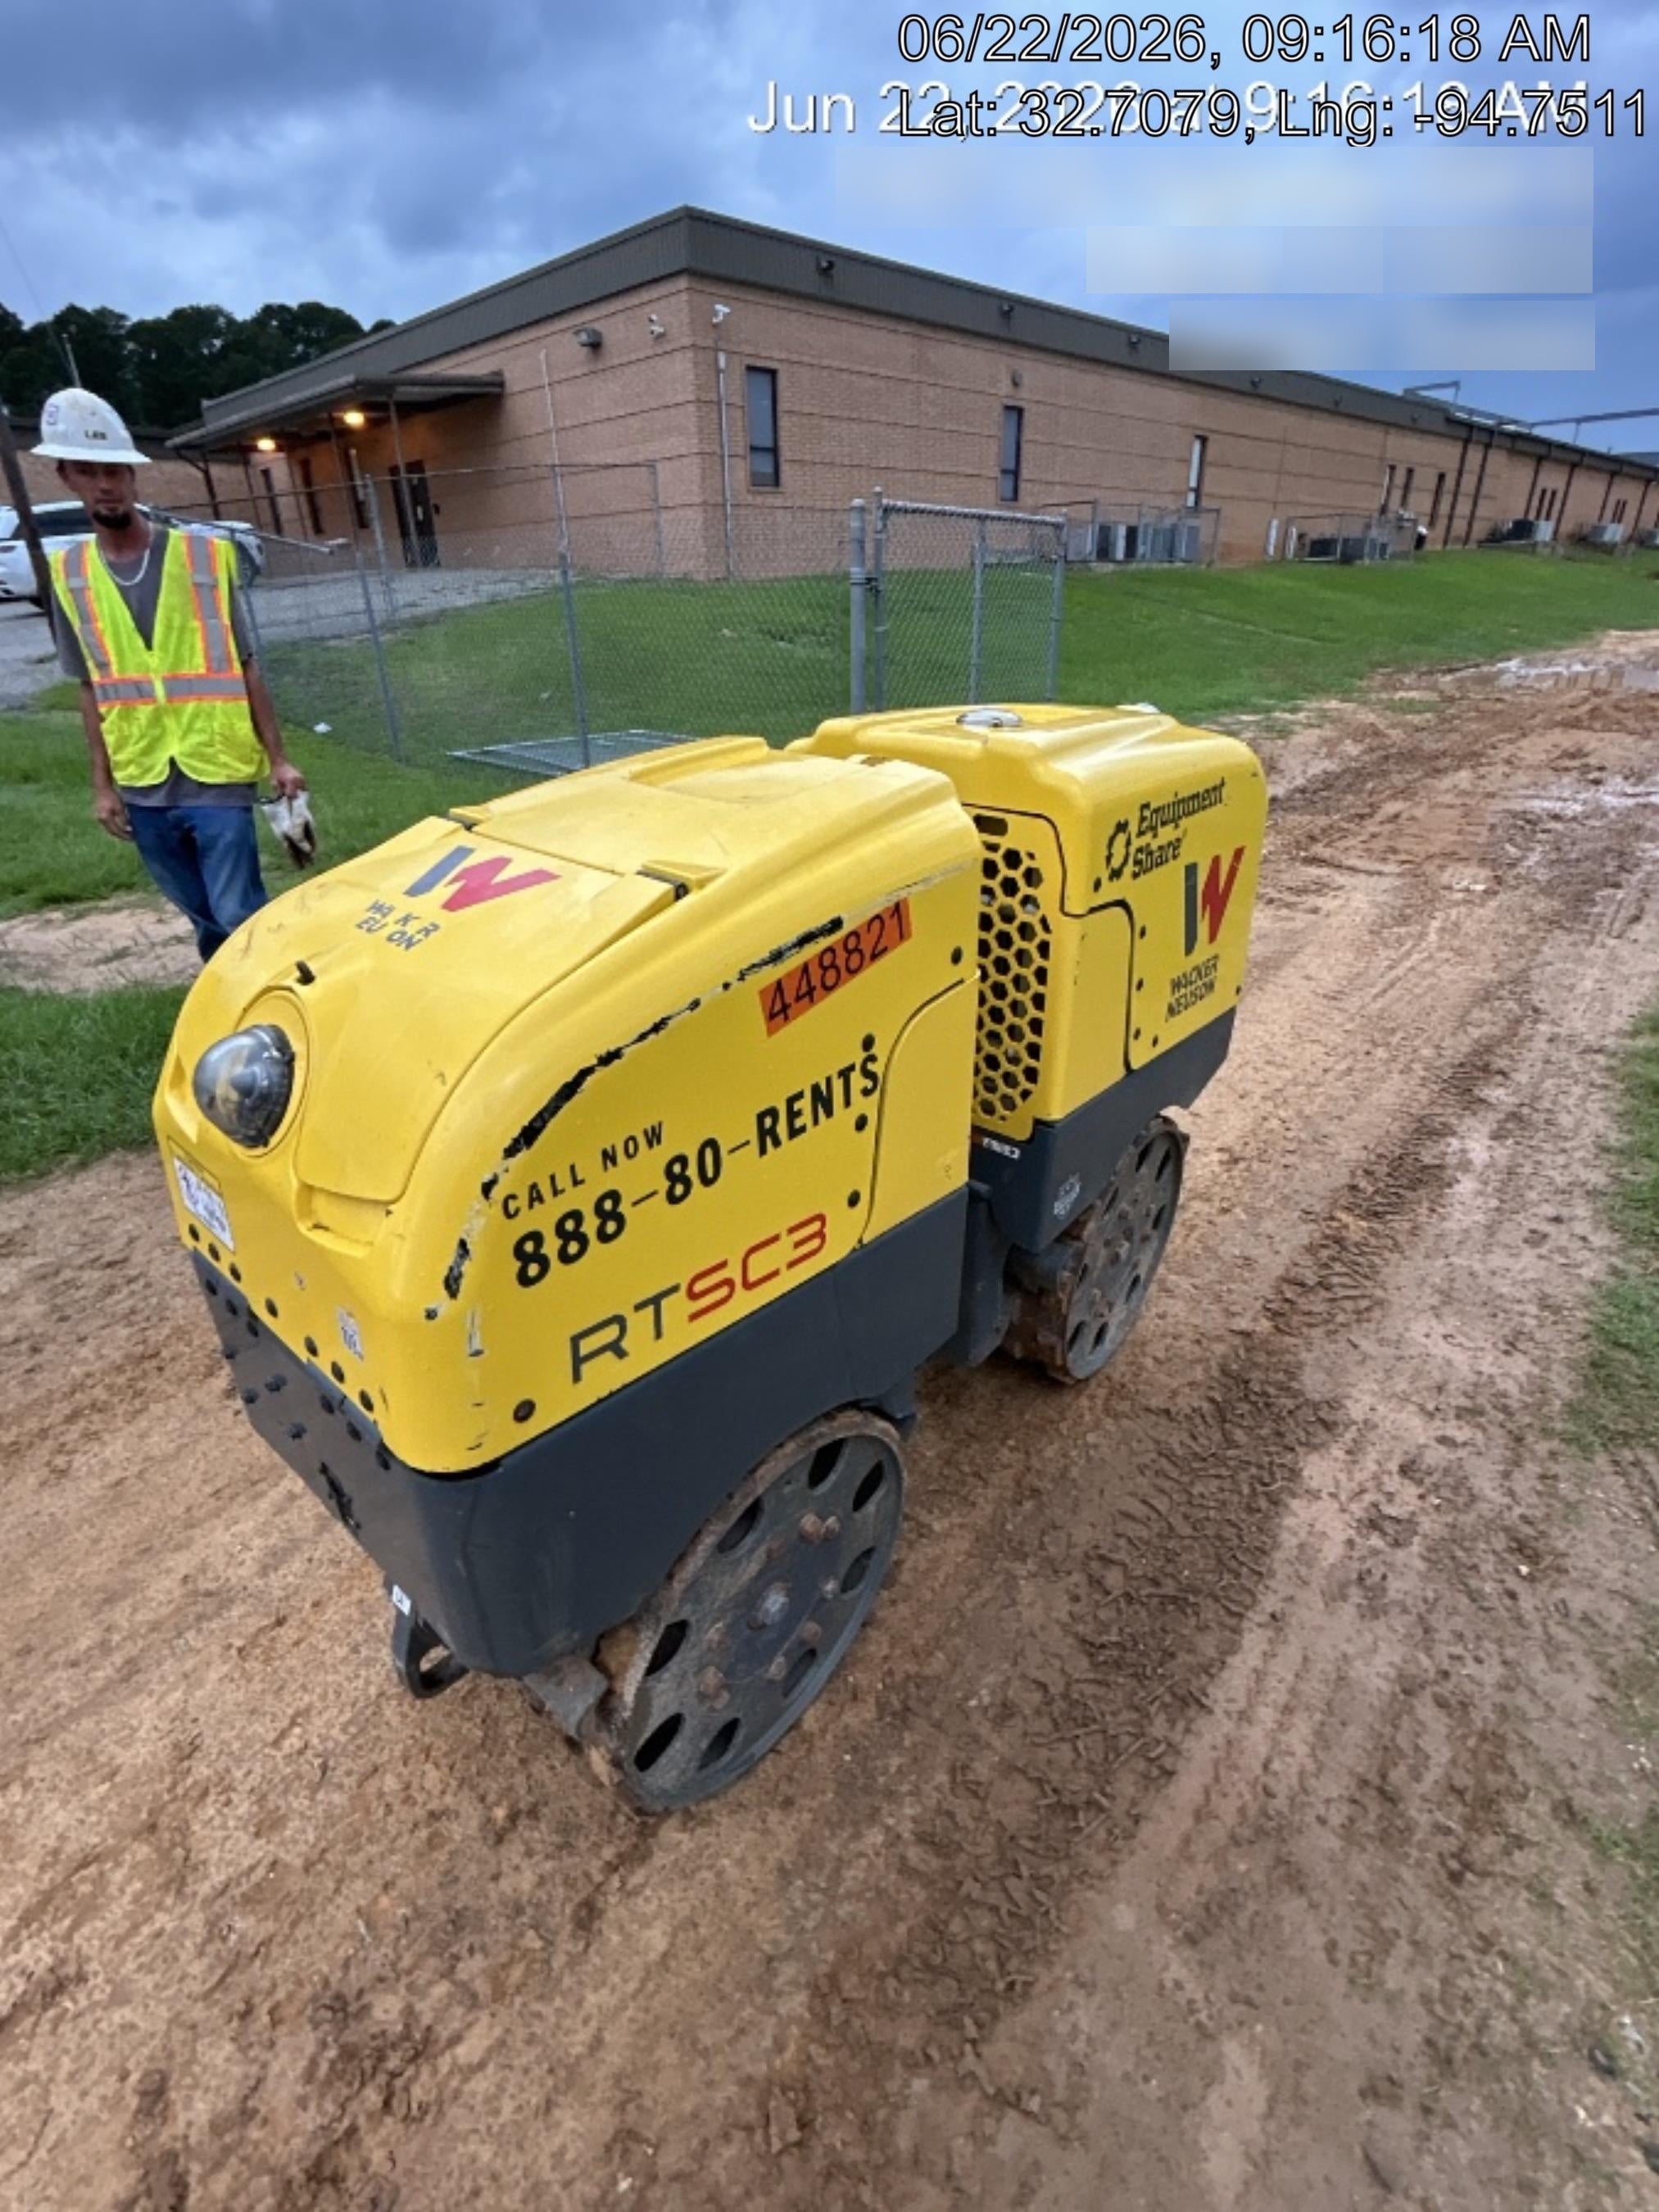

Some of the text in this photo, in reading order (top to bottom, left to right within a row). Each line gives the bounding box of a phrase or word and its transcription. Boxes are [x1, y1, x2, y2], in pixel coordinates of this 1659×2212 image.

[1135, 776, 1226, 839] Equipment
[1131, 836, 1182, 882] Share
[768, 902, 910, 1024] 448821
[502, 1120, 664, 1220] CALL NOW
[512, 1053, 881, 1289] 888-80-RENTS
